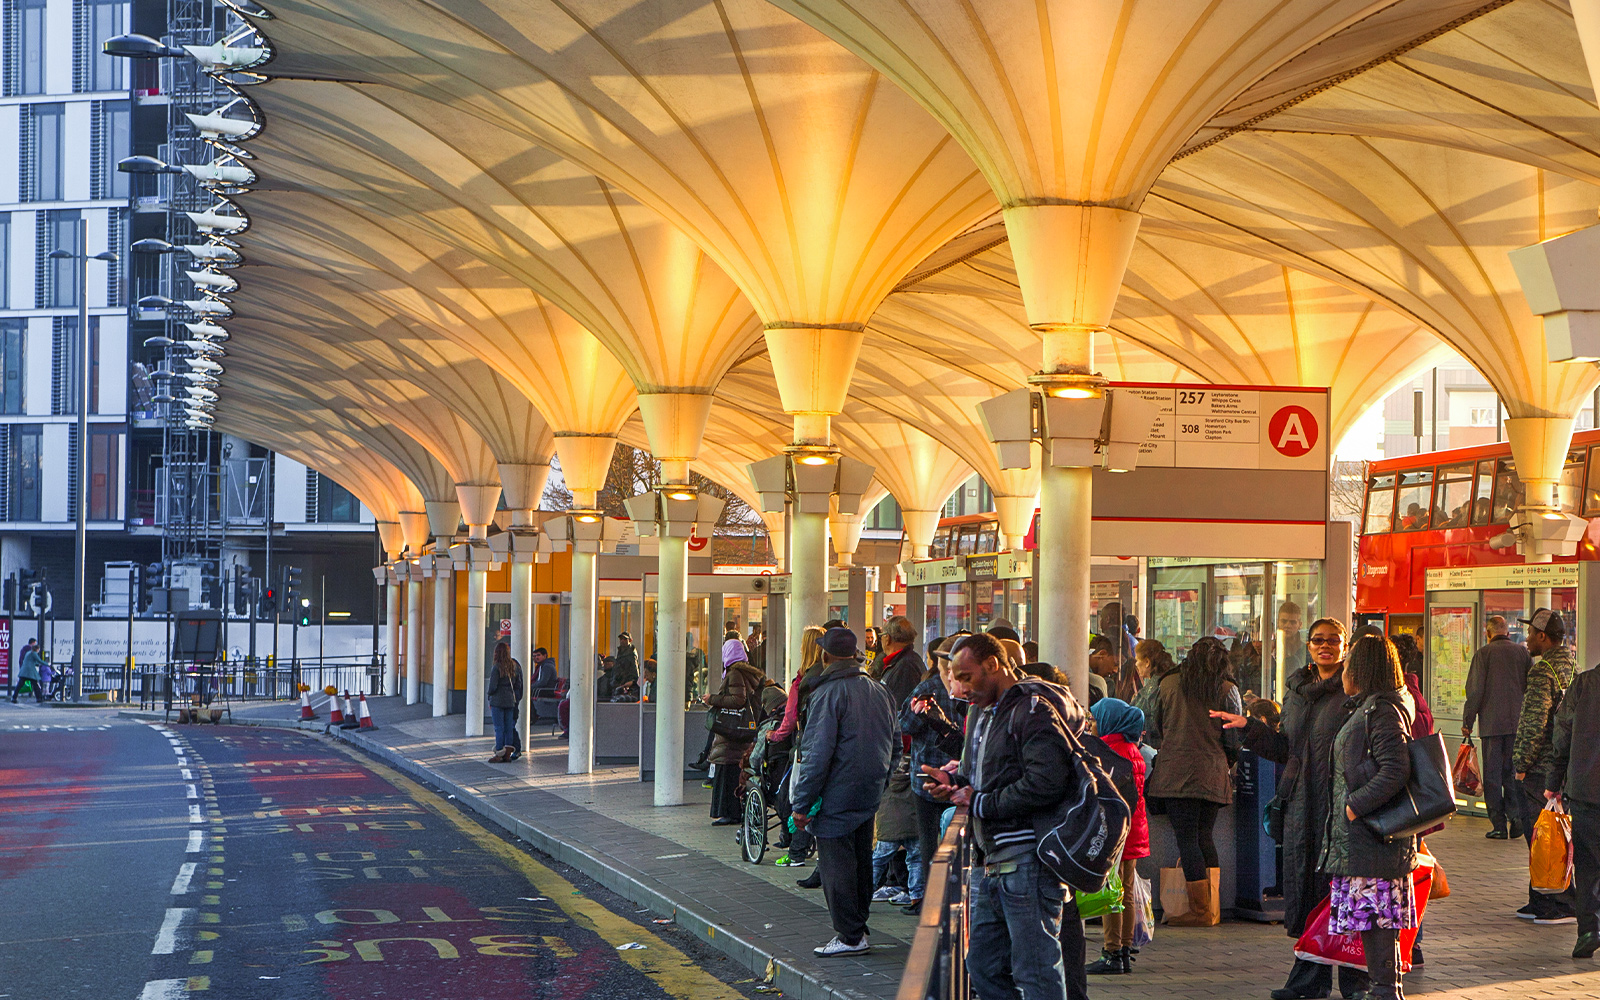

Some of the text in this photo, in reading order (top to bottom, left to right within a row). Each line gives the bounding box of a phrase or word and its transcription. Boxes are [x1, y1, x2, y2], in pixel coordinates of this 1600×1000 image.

[1179, 391, 1206, 405] 257
[1181, 424, 1200, 434] 308
[1277, 413, 1310, 449] A
[87, 648, 112, 656] bedroom
[112, 648, 147, 658] aparents
[298, 933, 578, 966] BUS
[1341, 944, 1362, 956] M&S
